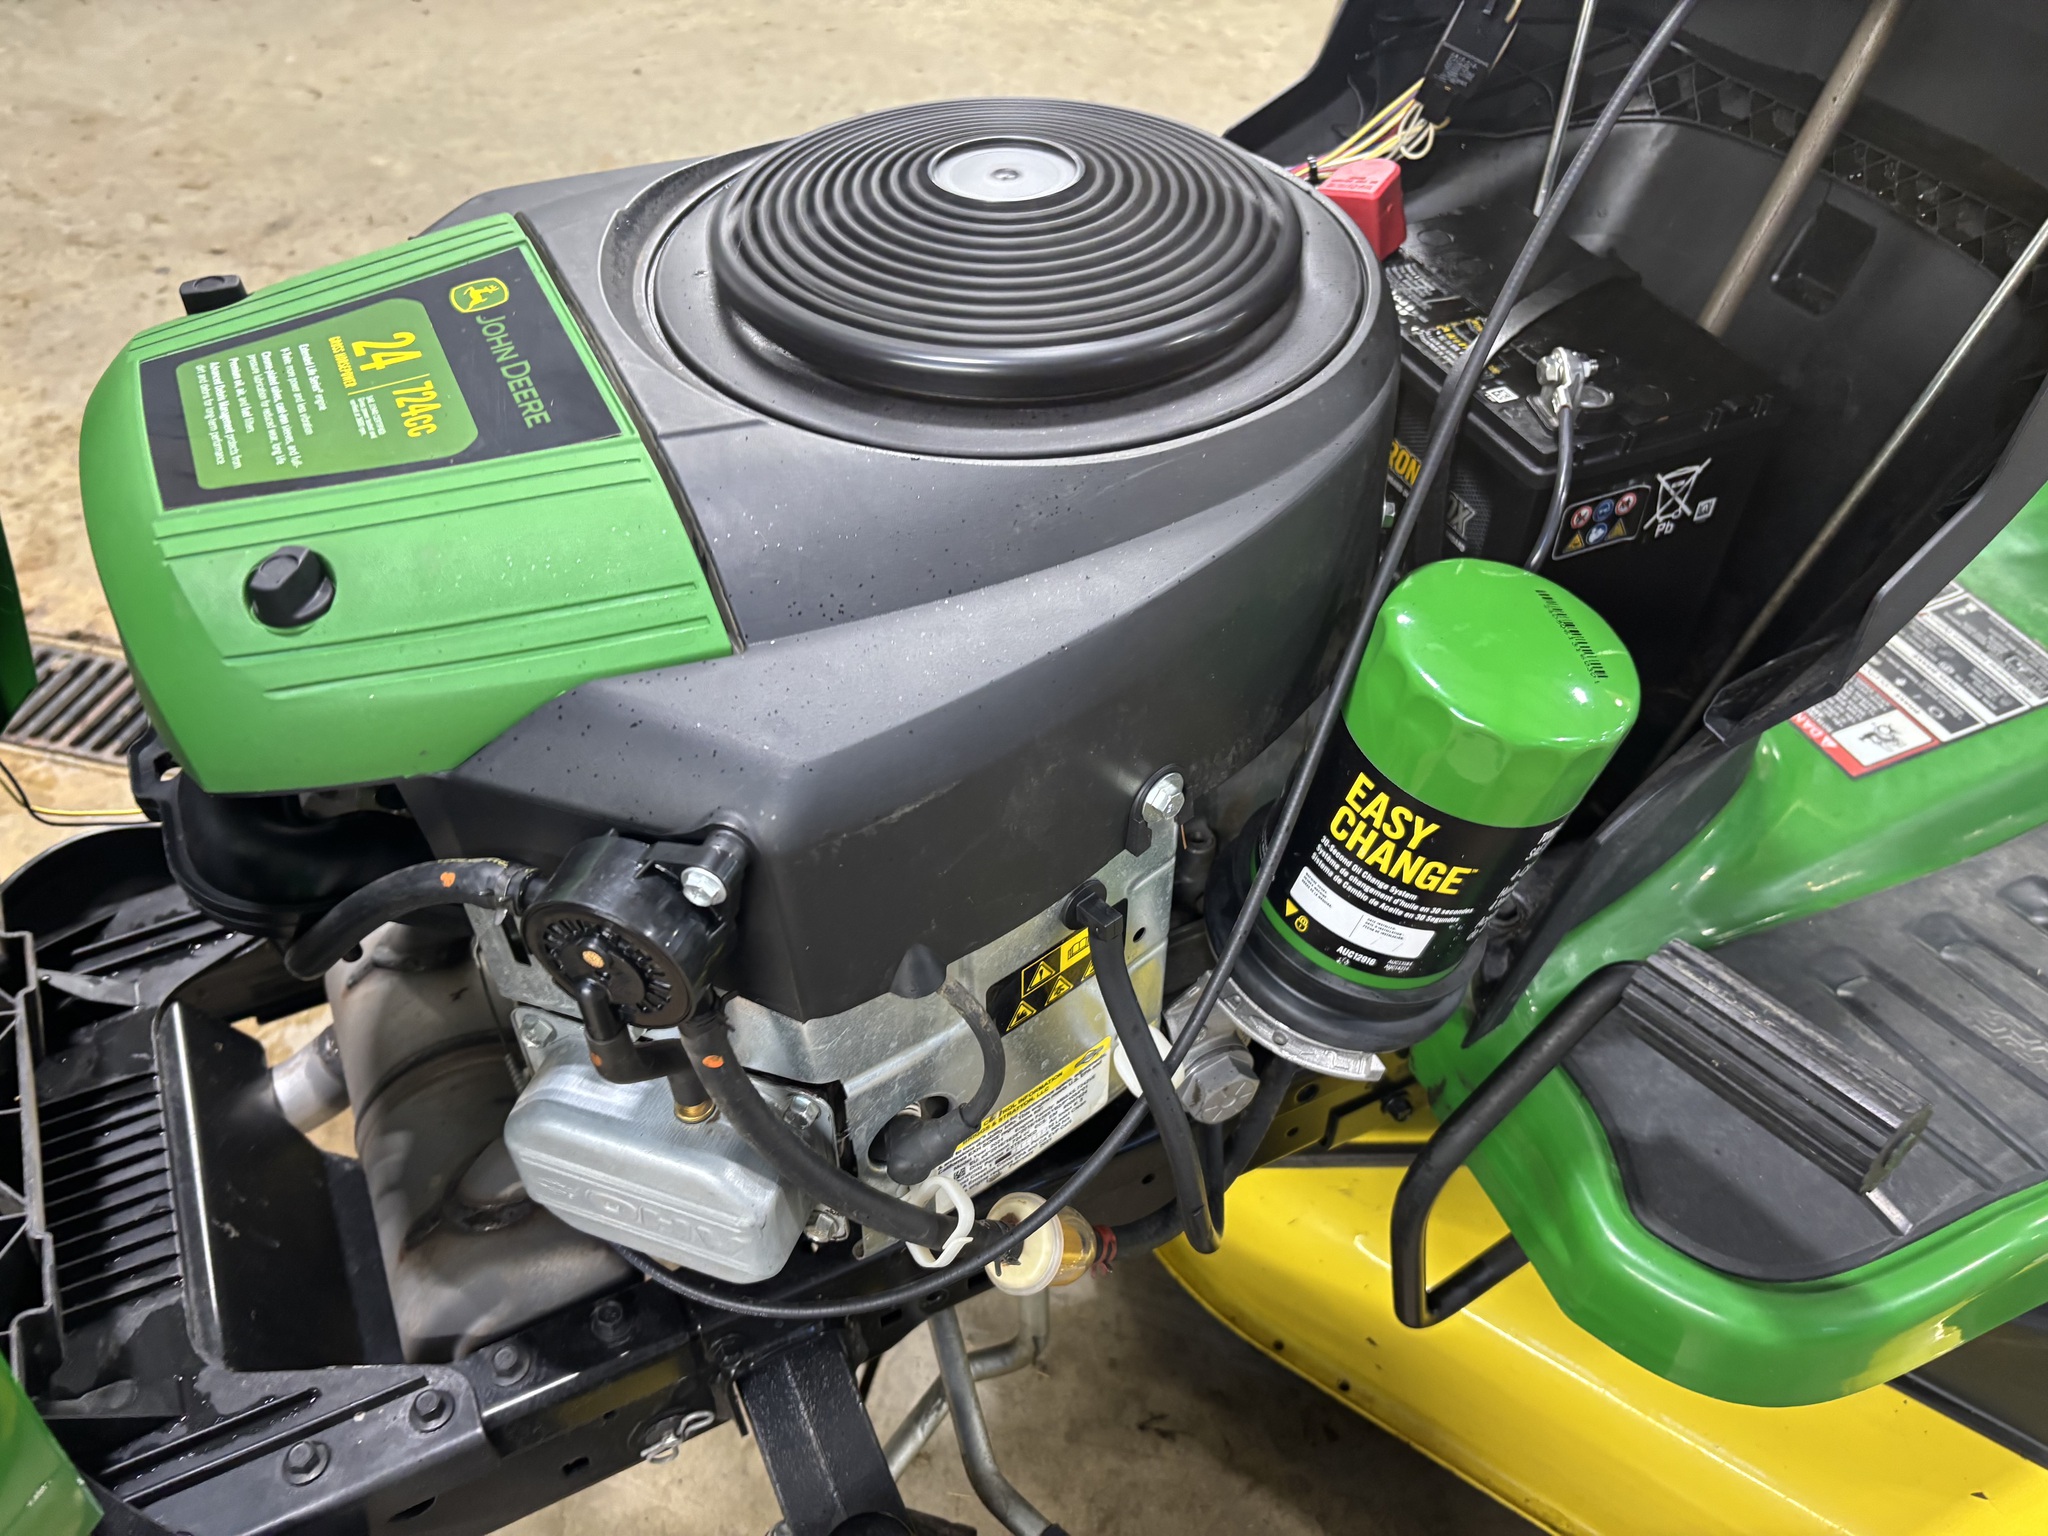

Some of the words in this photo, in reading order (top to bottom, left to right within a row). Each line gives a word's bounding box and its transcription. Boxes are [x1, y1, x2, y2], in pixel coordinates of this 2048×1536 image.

[328, 336, 345, 354] GROSS
[352, 332, 421, 371] 24
[298, 343, 314, 366] Extended
[195, 364, 206, 374] dirt
[209, 361, 224, 385] Advanced
[229, 357, 241, 380] Premium
[246, 354, 260, 375] pressure
[286, 365, 296, 378] more
[305, 365, 318, 376] Life
[335, 352, 357, 388] HORSEPOWER
[476, 315, 518, 362] JOHN
[501, 361, 550, 428] DEERE
[197, 373, 209, 384] and
[253, 374, 267, 400] lubrication
[287, 377, 301, 392] power
[200, 383, 211, 400] debris
[214, 384, 227, 402] Debris
[293, 392, 305, 403] and
[203, 398, 214, 407] for
[238, 396, 250, 408] and
[260, 399, 271, 408] for
[261, 351, 280, 386] Chrome-plated
[287, 445, 300, 456] and
[297, 402, 307, 414] less
[314, 393, 327, 411] engine
[393, 381, 440, 437] 724cc
[218, 400, 235, 434] Management
[241, 406, 253, 418] fuel
[263, 407, 277, 429] reduced
[300, 413, 313, 435] vibration
[224, 433, 239, 456] protects
[271, 442, 283, 456] long
[231, 454, 242, 470] from
[275, 454, 286, 466] life
[1655, 523, 1675, 538] Pb
[1345, 772, 1441, 850] EASY
[1321, 835, 1353, 867] 30-Second
[1351, 864, 1363, 875] Oil
[1361, 871, 1389, 890] Change
[1389, 885, 1418, 901] System
[1311, 852, 1334, 878] Sistema
[1333, 875, 1343, 885] de
[1342, 881, 1369, 902] Cambio
[1368, 898, 1379, 907] de
[1379, 902, 1404, 916] Aceite
[1316, 844, 1340, 870] Système
[1339, 868, 1349, 878] de
[1348, 875, 1394, 902] changement
[1430, 907, 1442, 915] 30
[1018, 1072, 1063, 1104] INFORMATION
[1036, 1086, 1050, 1098] LLC
